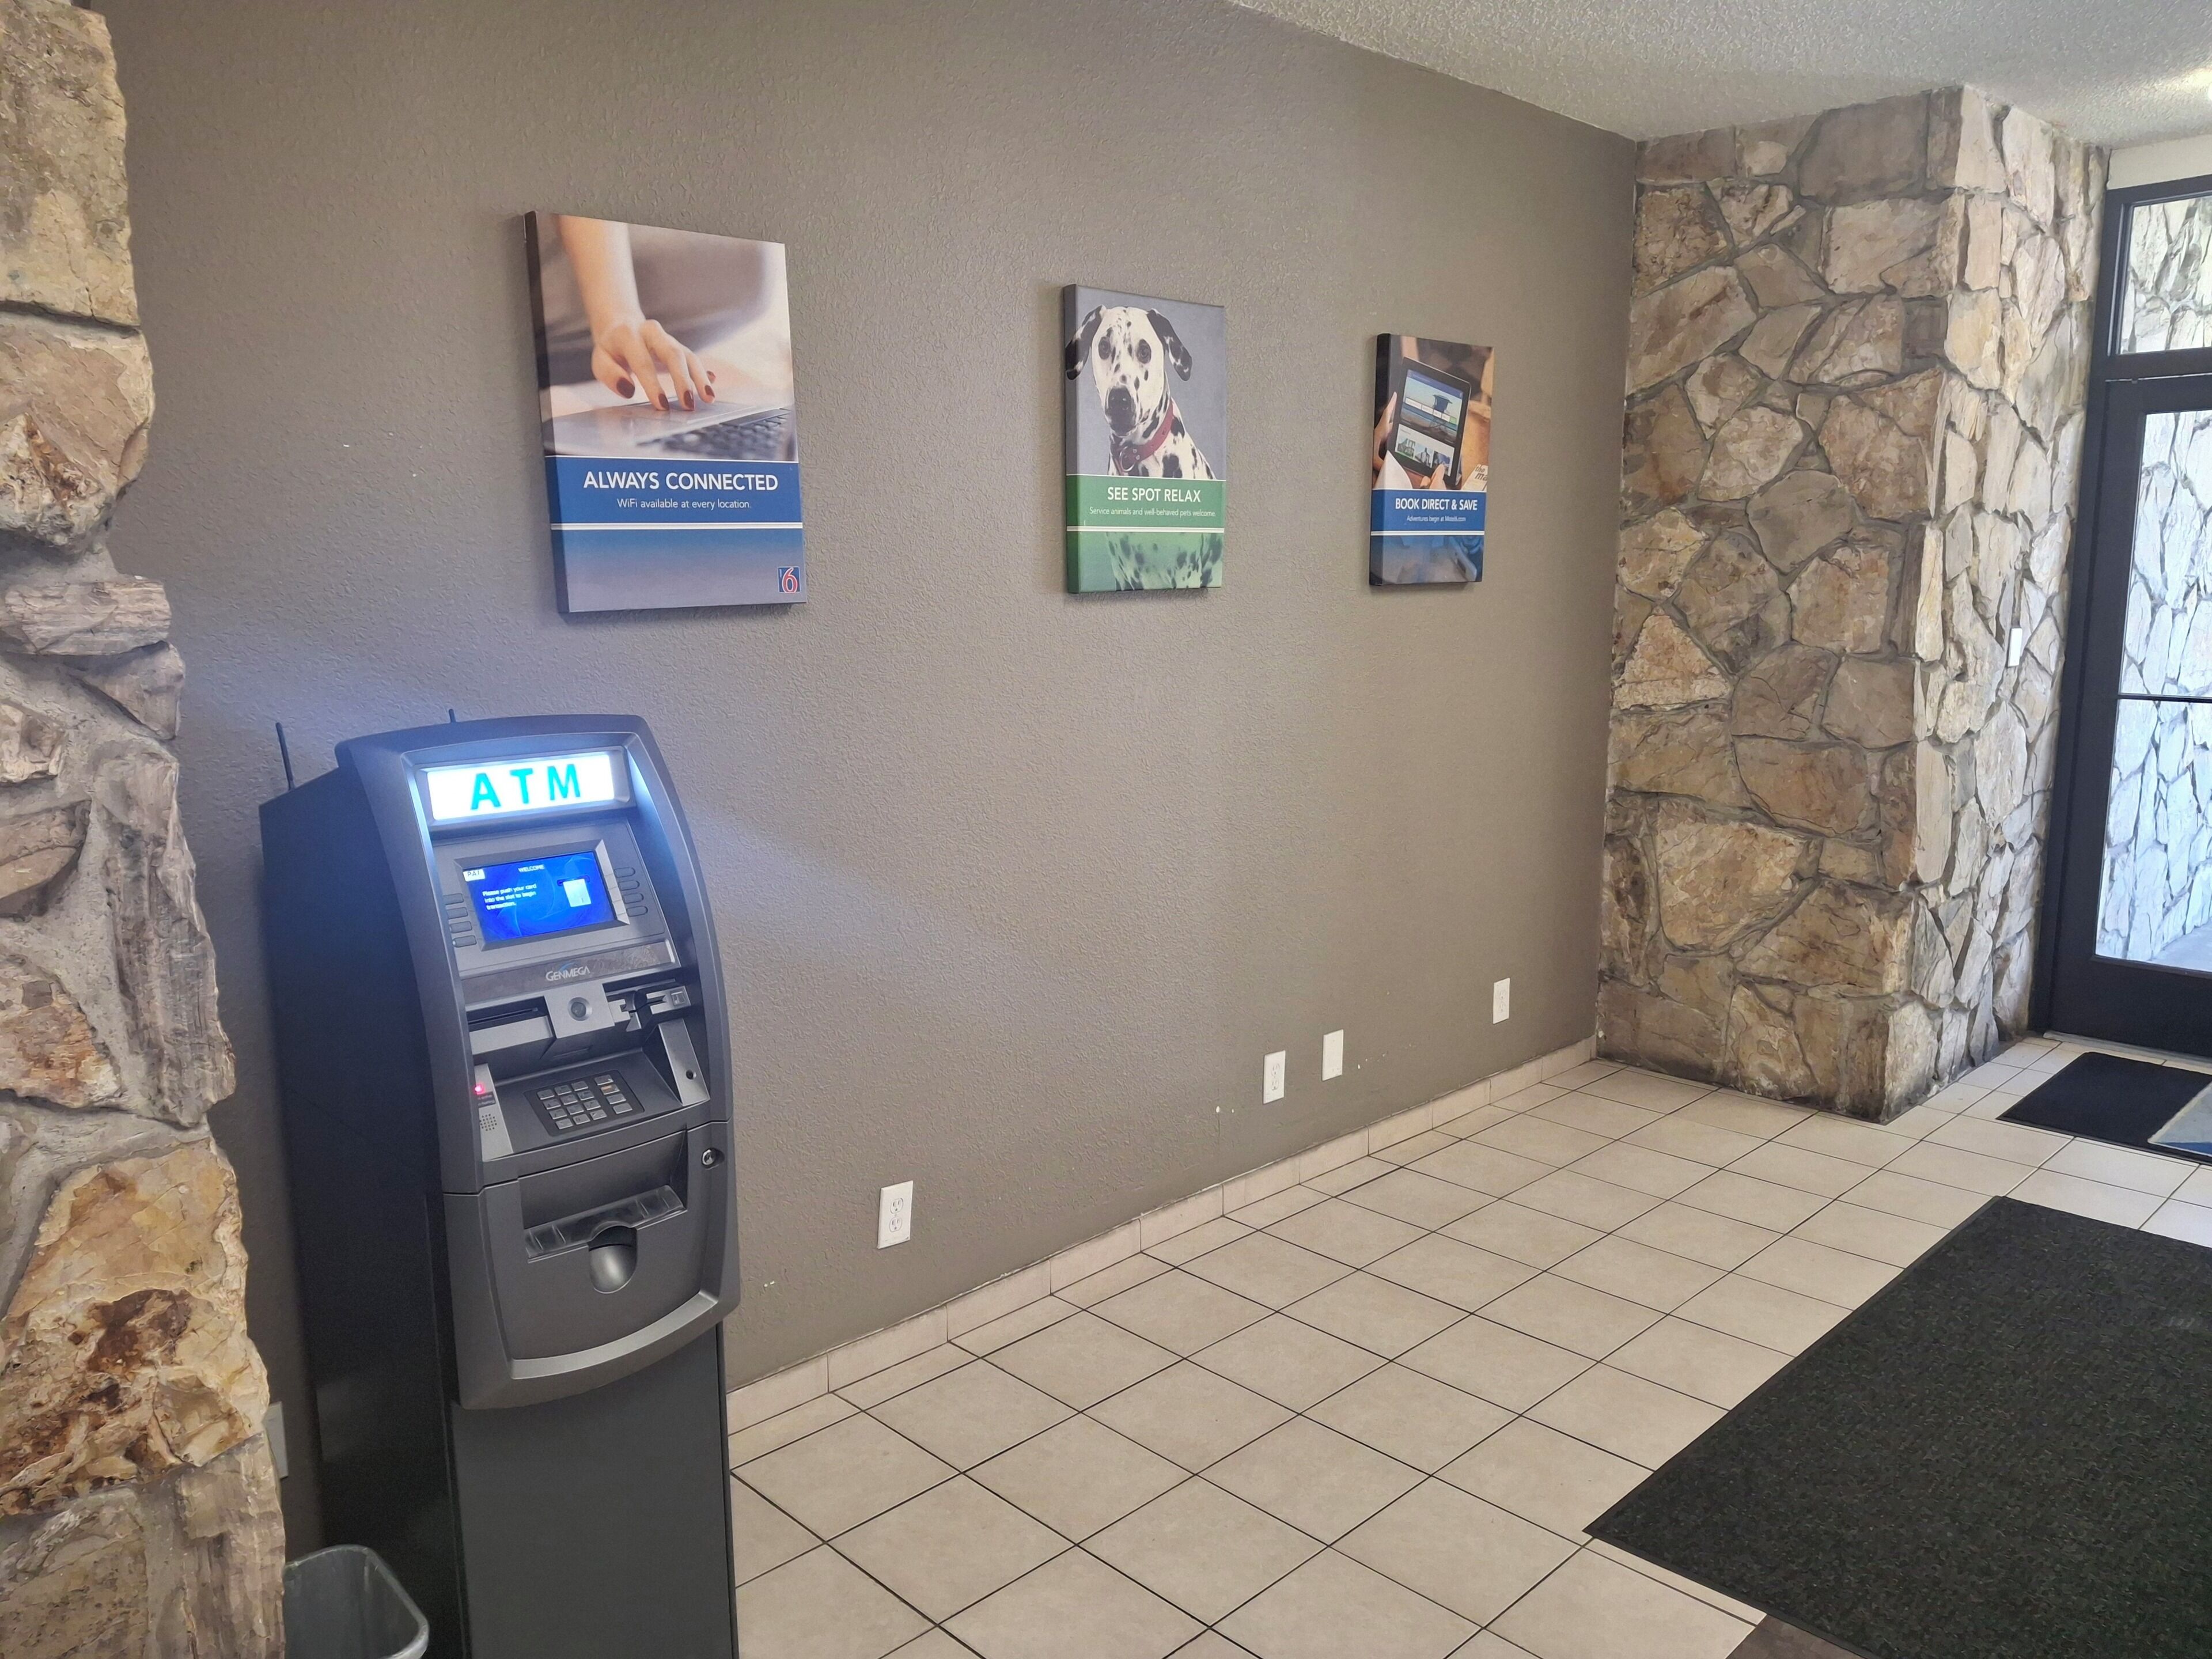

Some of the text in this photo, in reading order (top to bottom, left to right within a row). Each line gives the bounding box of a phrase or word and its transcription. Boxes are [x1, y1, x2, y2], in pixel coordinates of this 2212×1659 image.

[583, 471, 778, 490] ALWAYS CONNECTED
[1107, 486, 1201, 502] SEE SPOT RELAX
[617, 498, 638, 508] WiFi
[640, 498, 679, 508] available
[681, 500, 690, 508] at
[692, 501, 715, 511] every
[1089, 506, 1109, 514] Service
[1132, 507, 1143, 516] and
[1144, 507, 1179, 516] well-behaved
[1180, 509, 1192, 518] pets
[1395, 498, 1478, 510] BOOK DIRECT & SAVE
[782, 567, 798, 593] 6
[469, 763, 581, 810] ATM
[518, 864, 544, 873] WELCOME
[545, 965, 590, 982] GENMEGA
